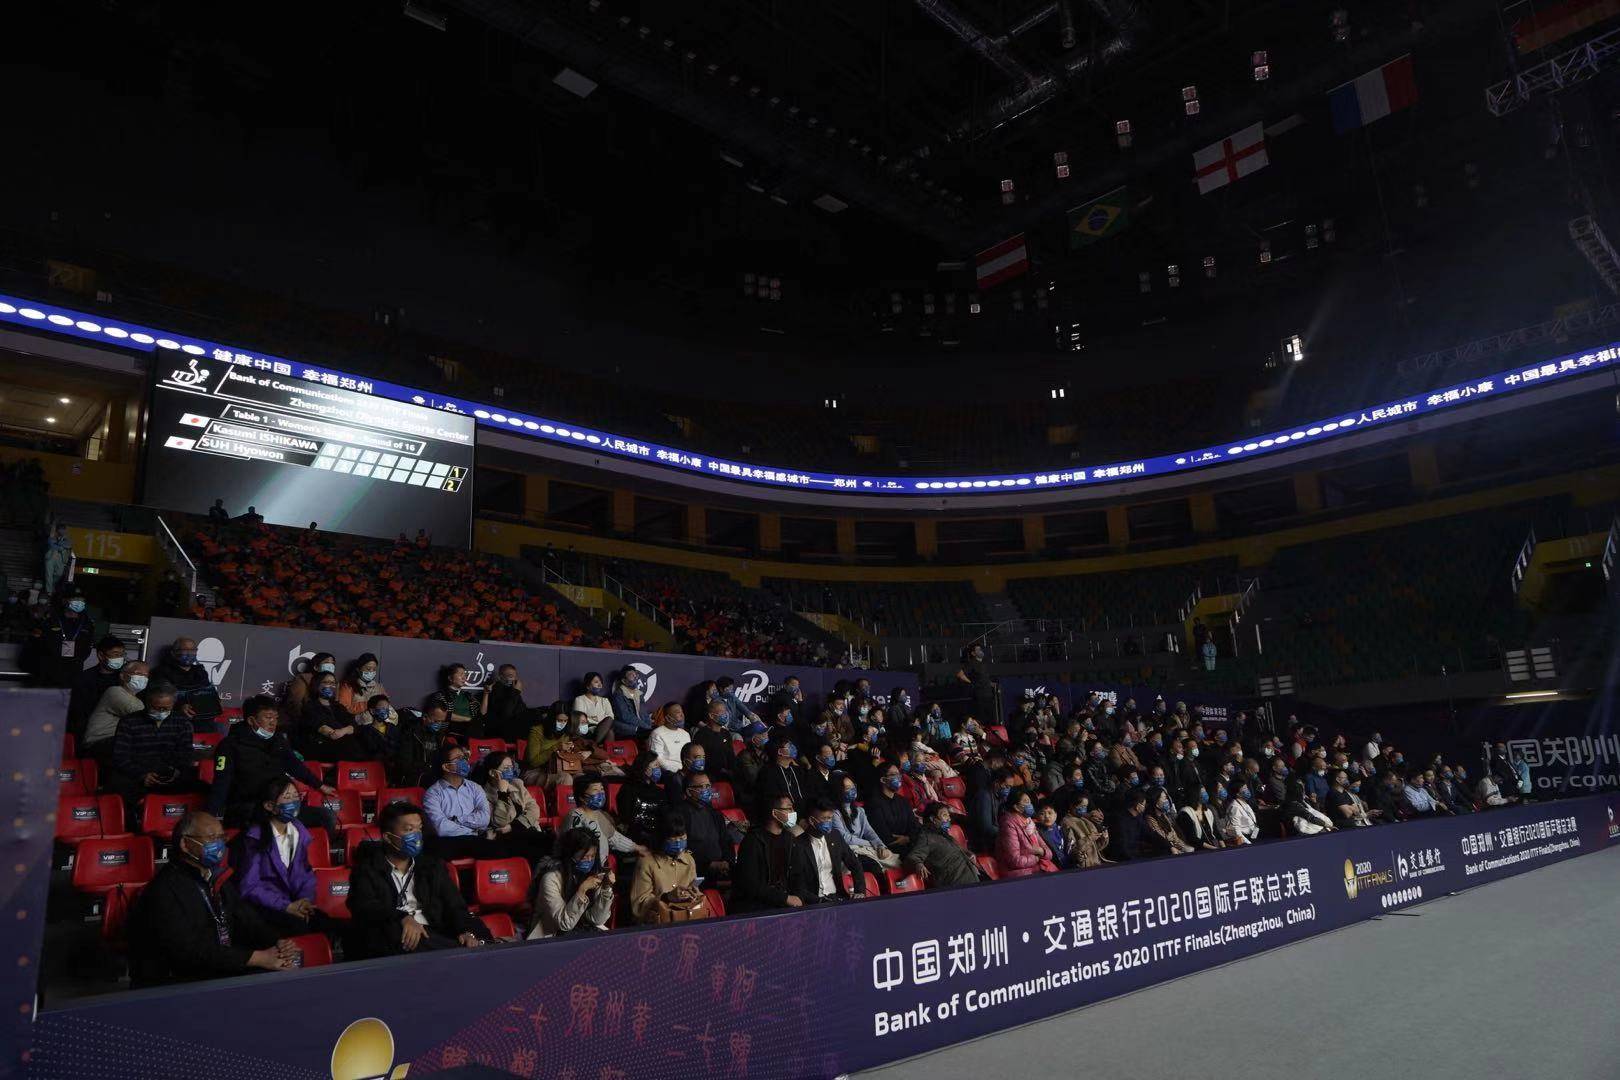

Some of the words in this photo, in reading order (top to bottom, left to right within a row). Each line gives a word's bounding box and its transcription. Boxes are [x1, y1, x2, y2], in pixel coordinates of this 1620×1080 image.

[229, 372, 257, 385] Bank
[259, 378, 271, 387] of
[1357, 401, 1418, 425] 人民城市
[1427, 381, 1494, 406] 幸福小康
[1504, 348, 1620, 385] 中国最具幸福
[213, 424, 257, 439] Kasumi
[259, 430, 319, 451] ISHIKAWA
[233, 410, 260, 423] Table
[393, 440, 404, 450] of
[405, 443, 416, 452] 16
[437, 428, 470, 441] Center
[202, 437, 231, 451] SUH
[234, 442, 284, 461] Hyowon
[601, 437, 650, 456] 人民城市
[453, 467, 460, 478] 1
[447, 481, 455, 491] 2
[84, 532, 124, 560] 115
[1537, 776, 1562, 789] OF
[1570, 774, 1620, 788] COM
[1356, 861, 1372, 875] 2020
[1465, 863, 1479, 875] Bank
[874, 1003, 931, 1037] Bank
[937, 993, 960, 1020] of
[965, 960, 1110, 1012] Communications
[1113, 946, 1150, 971] 2020
[1152, 938, 1181, 962] ITTF
[1286, 903, 1316, 925] China)
